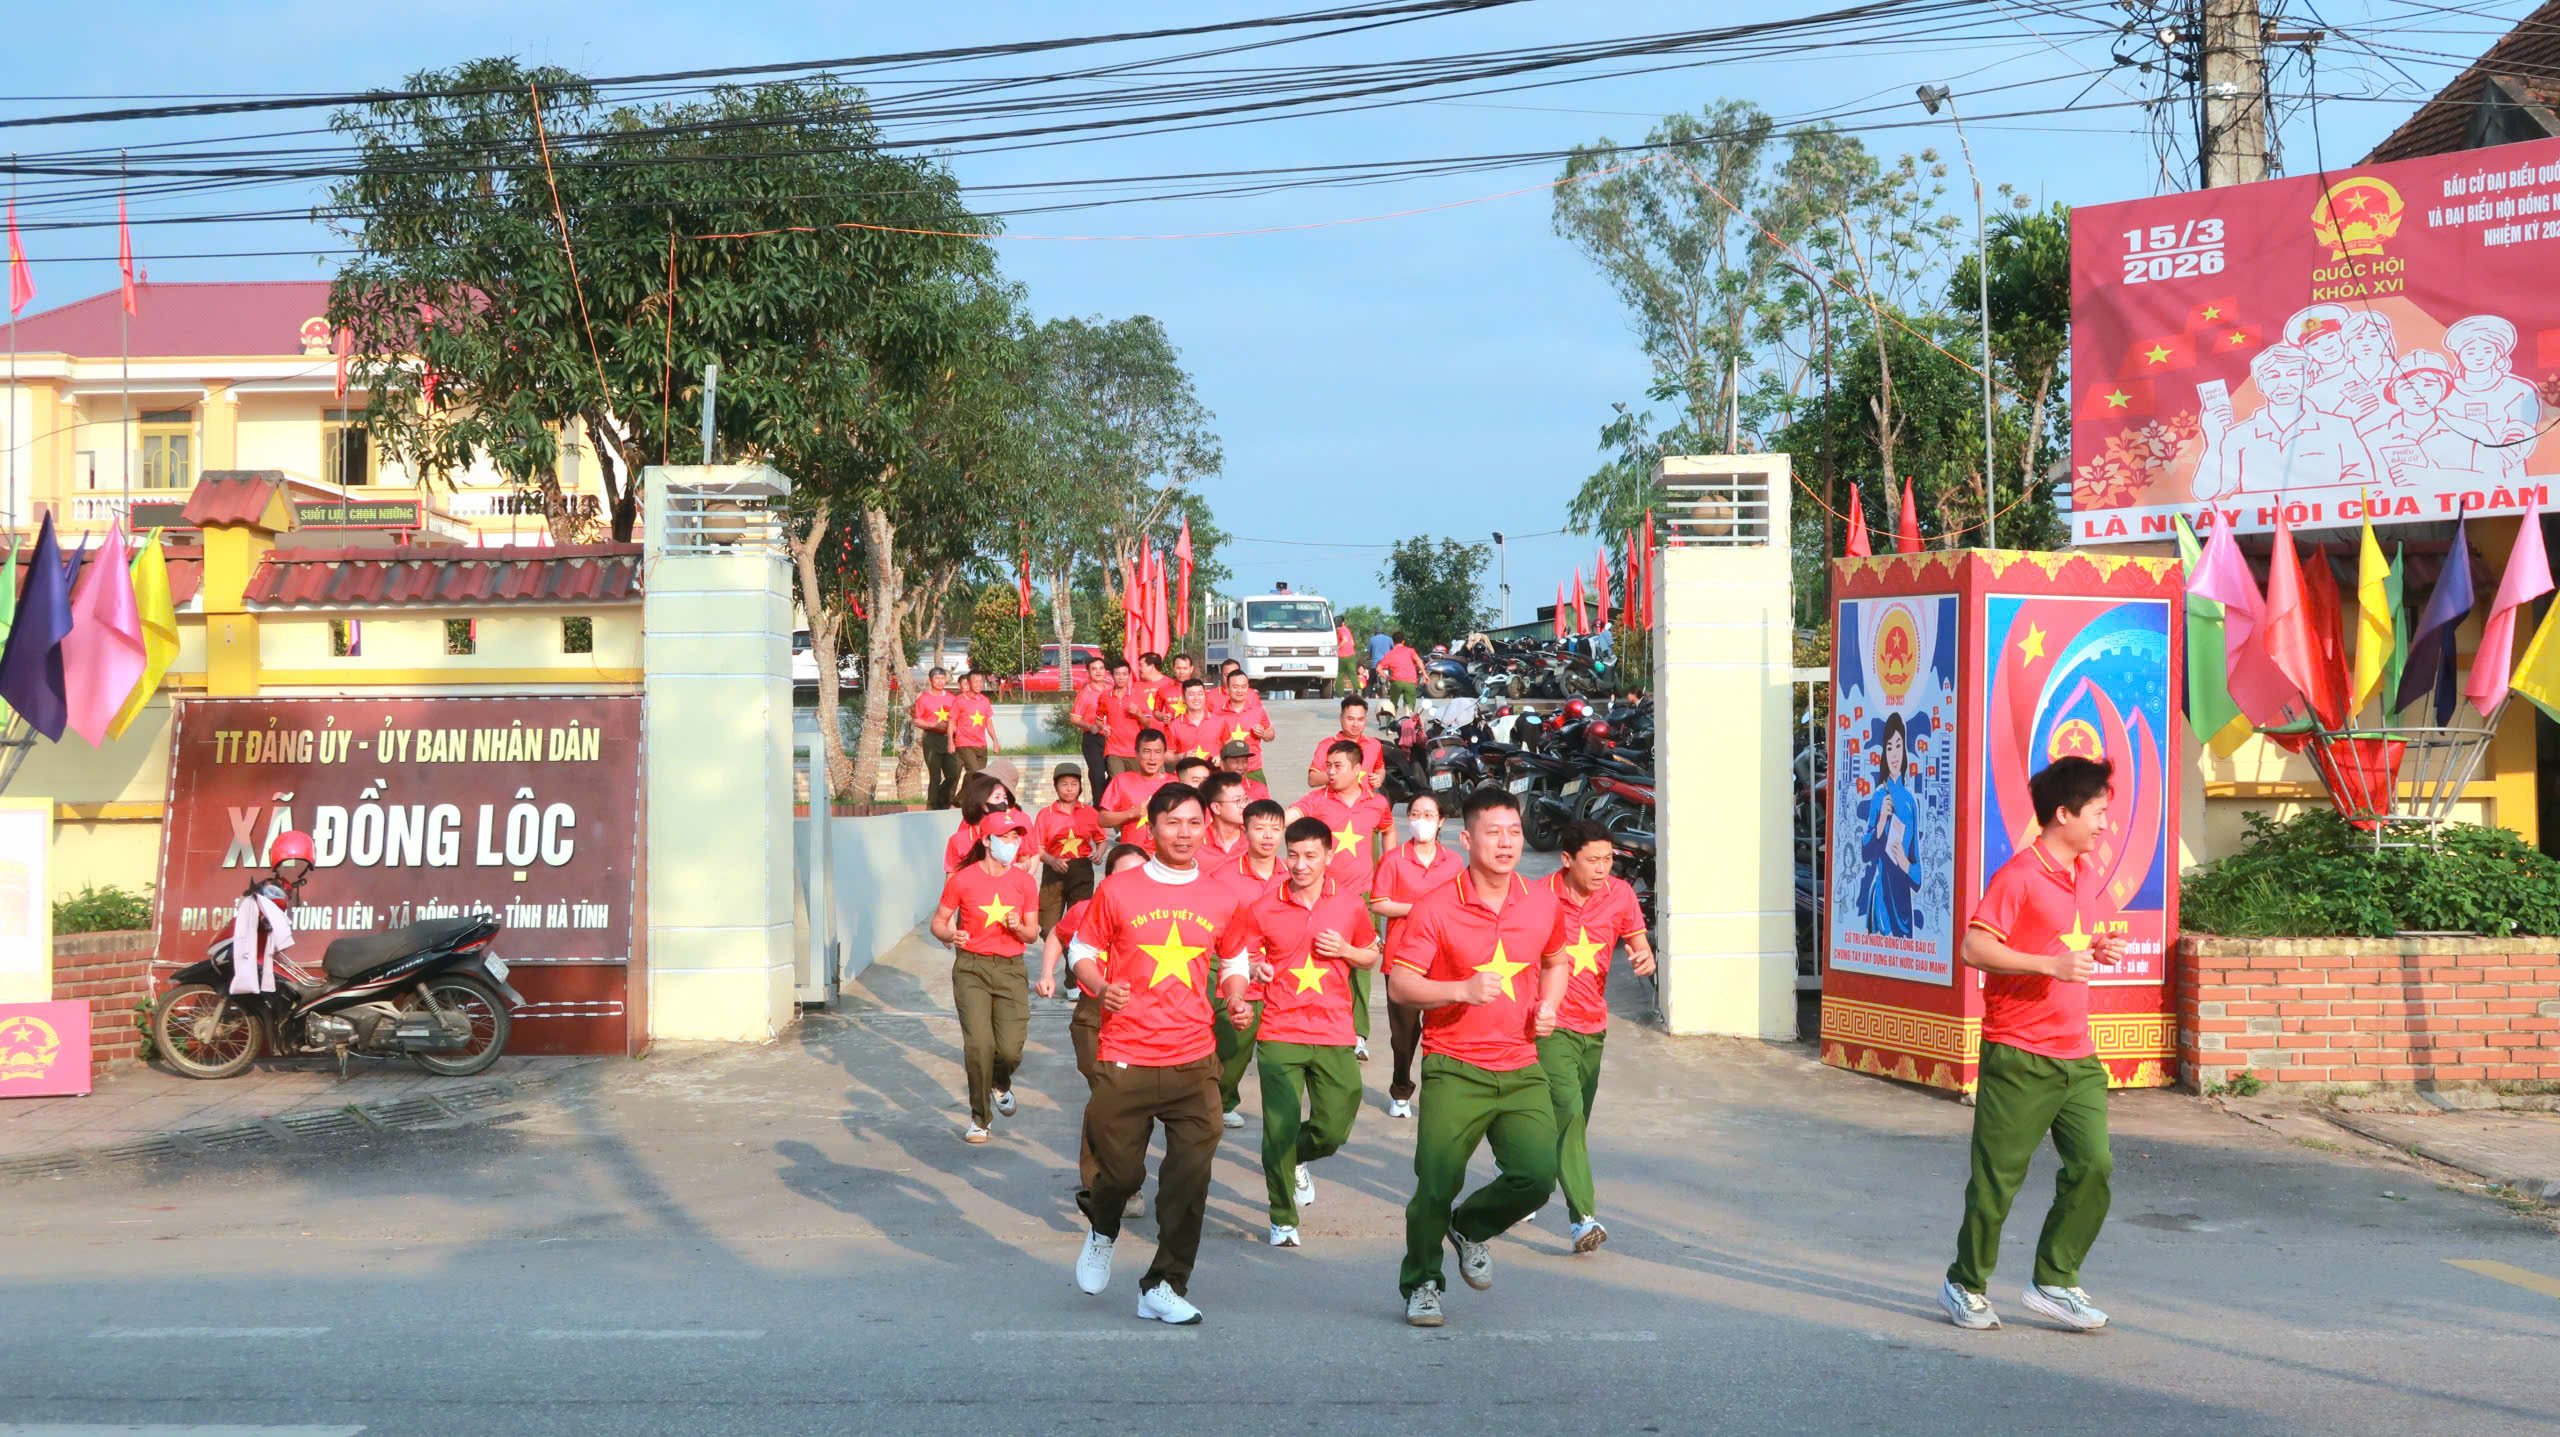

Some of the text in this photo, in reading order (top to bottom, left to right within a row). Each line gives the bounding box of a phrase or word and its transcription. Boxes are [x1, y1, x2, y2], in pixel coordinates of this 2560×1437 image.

[2469, 168, 2486, 194] CỬ
[2488, 172, 2506, 194] ĐẠI
[2510, 162, 2536, 188] BIỂU
[2428, 206, 2443, 228] VÀ
[2446, 206, 2464, 228] ĐẠI
[2467, 196, 2493, 222] BIỂU
[2496, 196, 2515, 221] HỘI
[2518, 192, 2550, 216] ĐỒNG
[2123, 218, 2224, 252] 15/3
[2484, 223, 2521, 248] NHIỆM
[2524, 220, 2540, 241] KỲ
[2123, 250, 2224, 284] 2026
[2313, 256, 2404, 282] QUỐC HỘI
[2313, 278, 2404, 300] KHÓA XVI
[349, 508, 377, 522] CHỌN
[379, 506, 414, 520] NHỮNG
[2085, 514, 2128, 538] LÀ
[2338, 490, 2421, 519] CỦA
[2434, 486, 2548, 512] TOÀN
[215, 730, 243, 764] TT
[245, 716, 314, 764] ĐẢNG
[319, 716, 352, 764] ỦY
[378, 716, 411, 763] ỦY
[416, 729, 468, 762] BAN
[472, 720, 543, 762] NHÂN
[548, 719, 600, 762] DÂN
[222, 778, 576, 882] XÃ ĐỒNG LỘC
[181, 907, 208, 936] ĐỊA
[292, 901, 332, 930] TÙNG
[336, 901, 374, 930] LIÊN
[388, 901, 410, 929] XÃ
[505, 895, 542, 929] TỈNH
[546, 898, 568, 929] HÀ
[572, 899, 609, 929] TĨNH
[1131, 907, 1216, 932] TÔI YÊU VIỆT NAM
